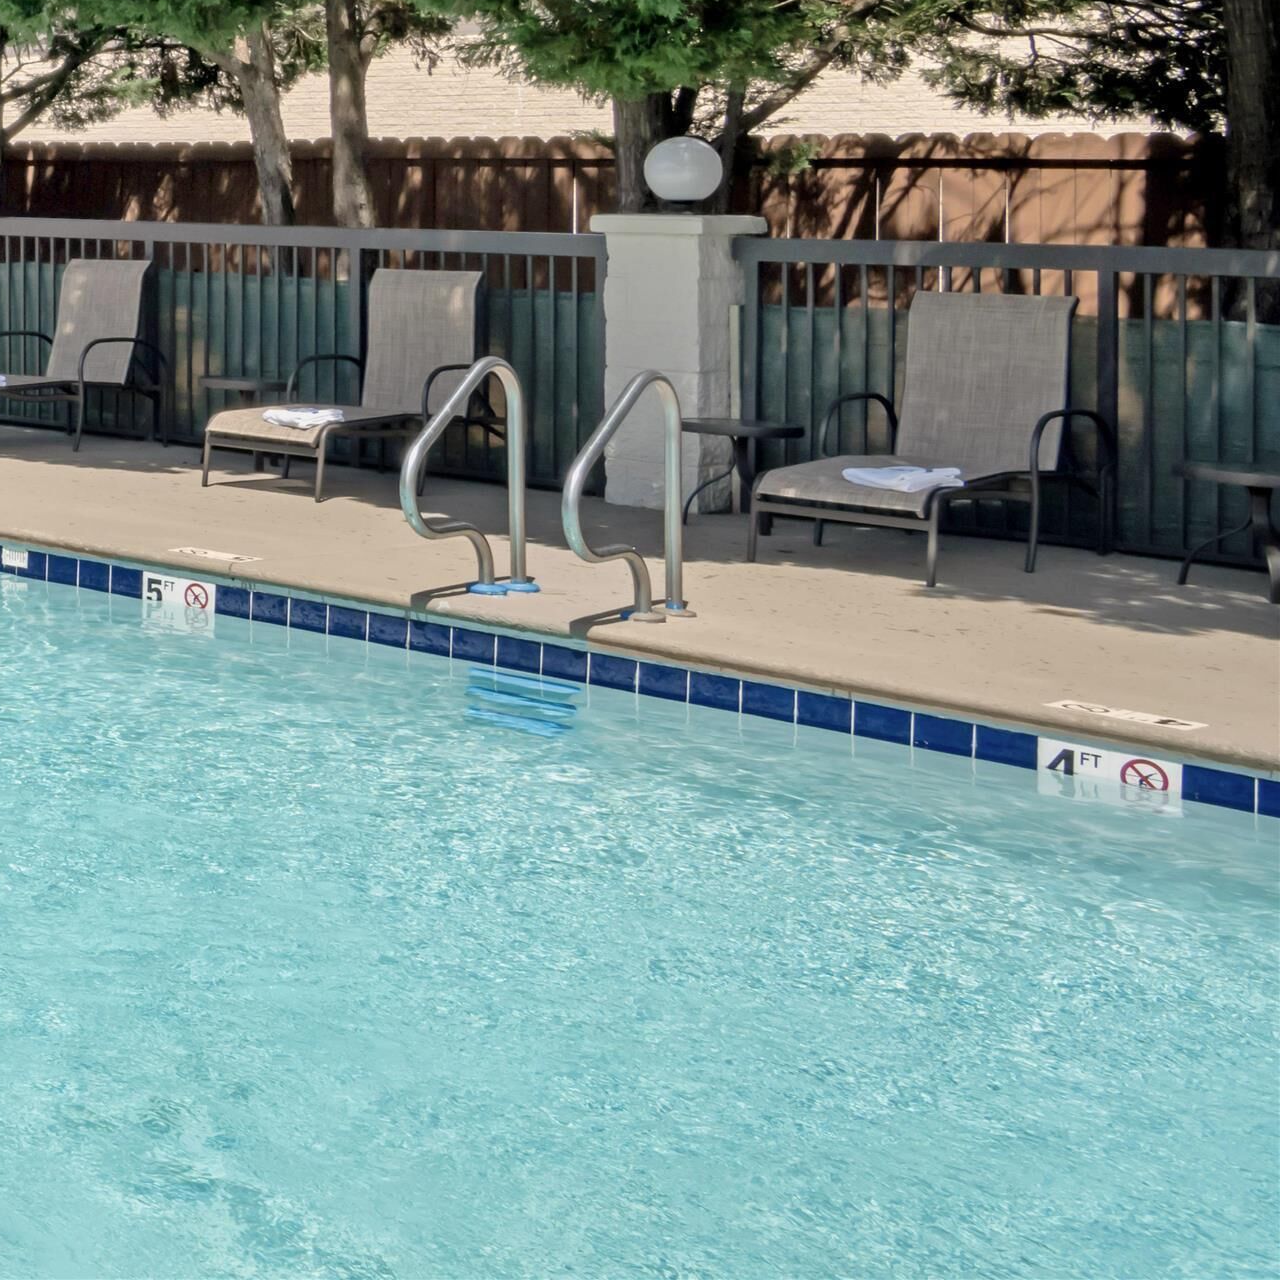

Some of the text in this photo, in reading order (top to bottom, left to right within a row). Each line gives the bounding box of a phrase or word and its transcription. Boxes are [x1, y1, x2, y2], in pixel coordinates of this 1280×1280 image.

[146, 577, 175, 601] 5 FT
[1046, 749, 1102, 776] 4 FT
